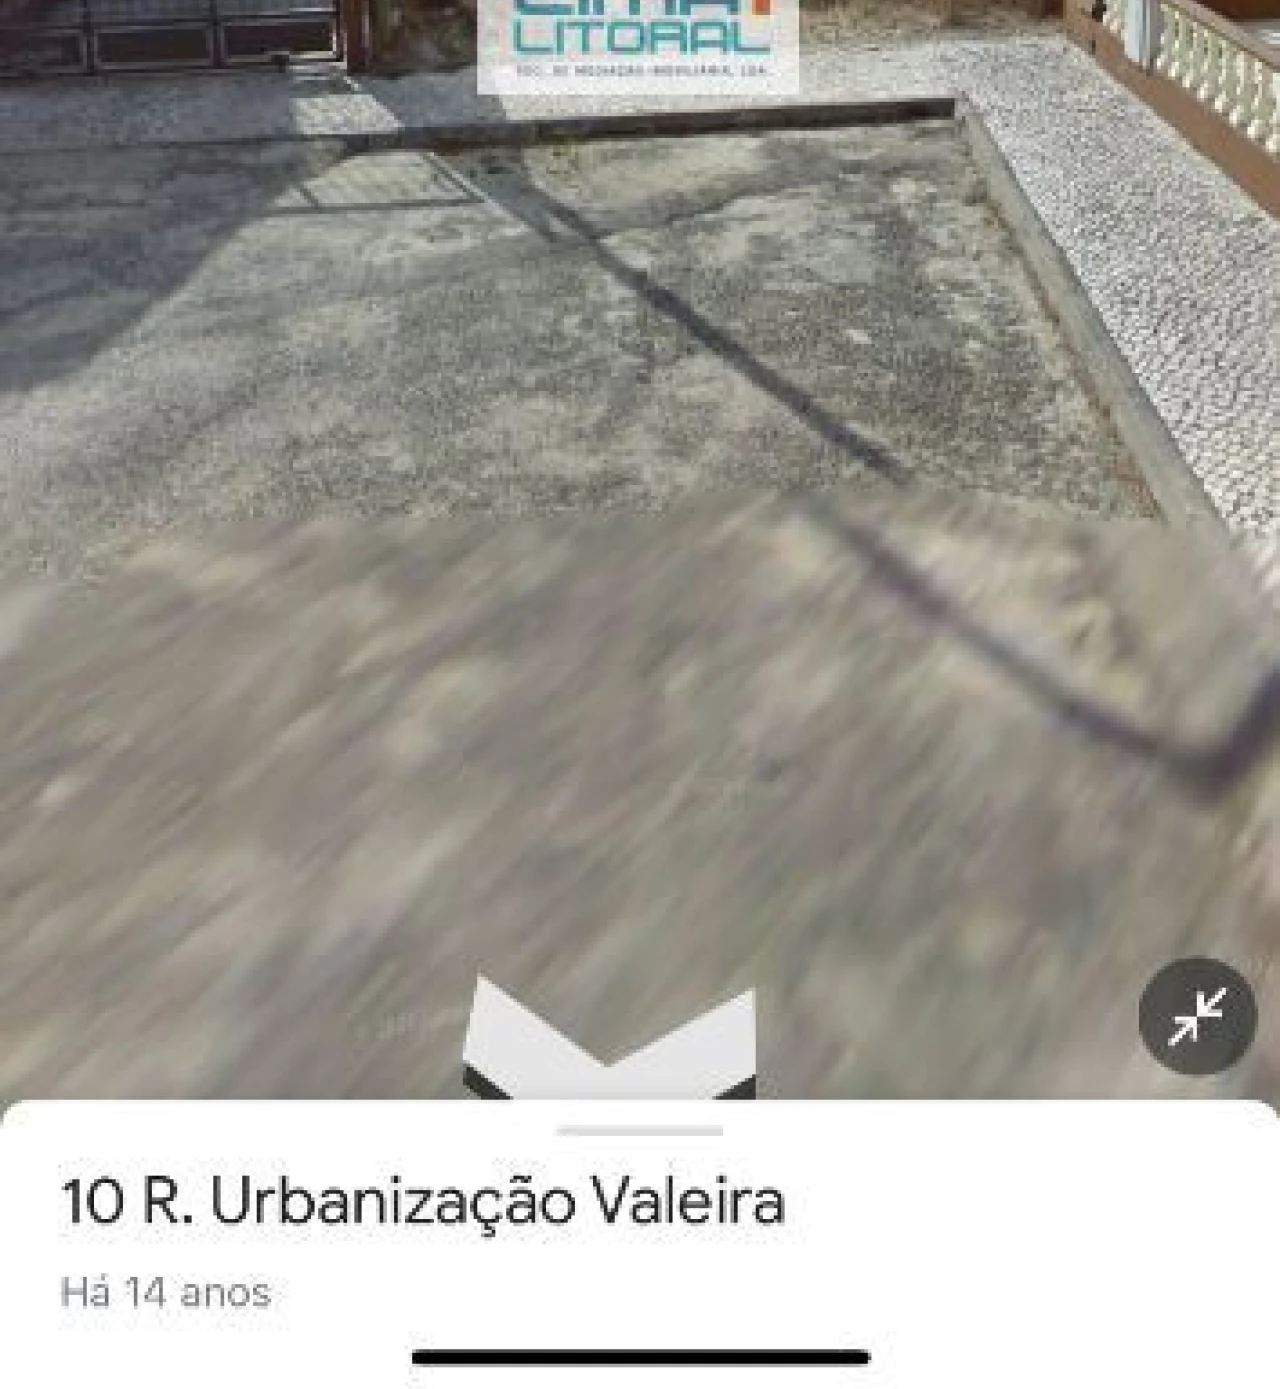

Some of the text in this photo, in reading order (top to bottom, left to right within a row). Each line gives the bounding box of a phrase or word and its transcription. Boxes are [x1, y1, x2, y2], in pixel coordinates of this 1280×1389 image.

[61, 1174, 785, 1238] 10 R. Urbanização Valeira
[61, 1273, 272, 1307] Há 14 anos
